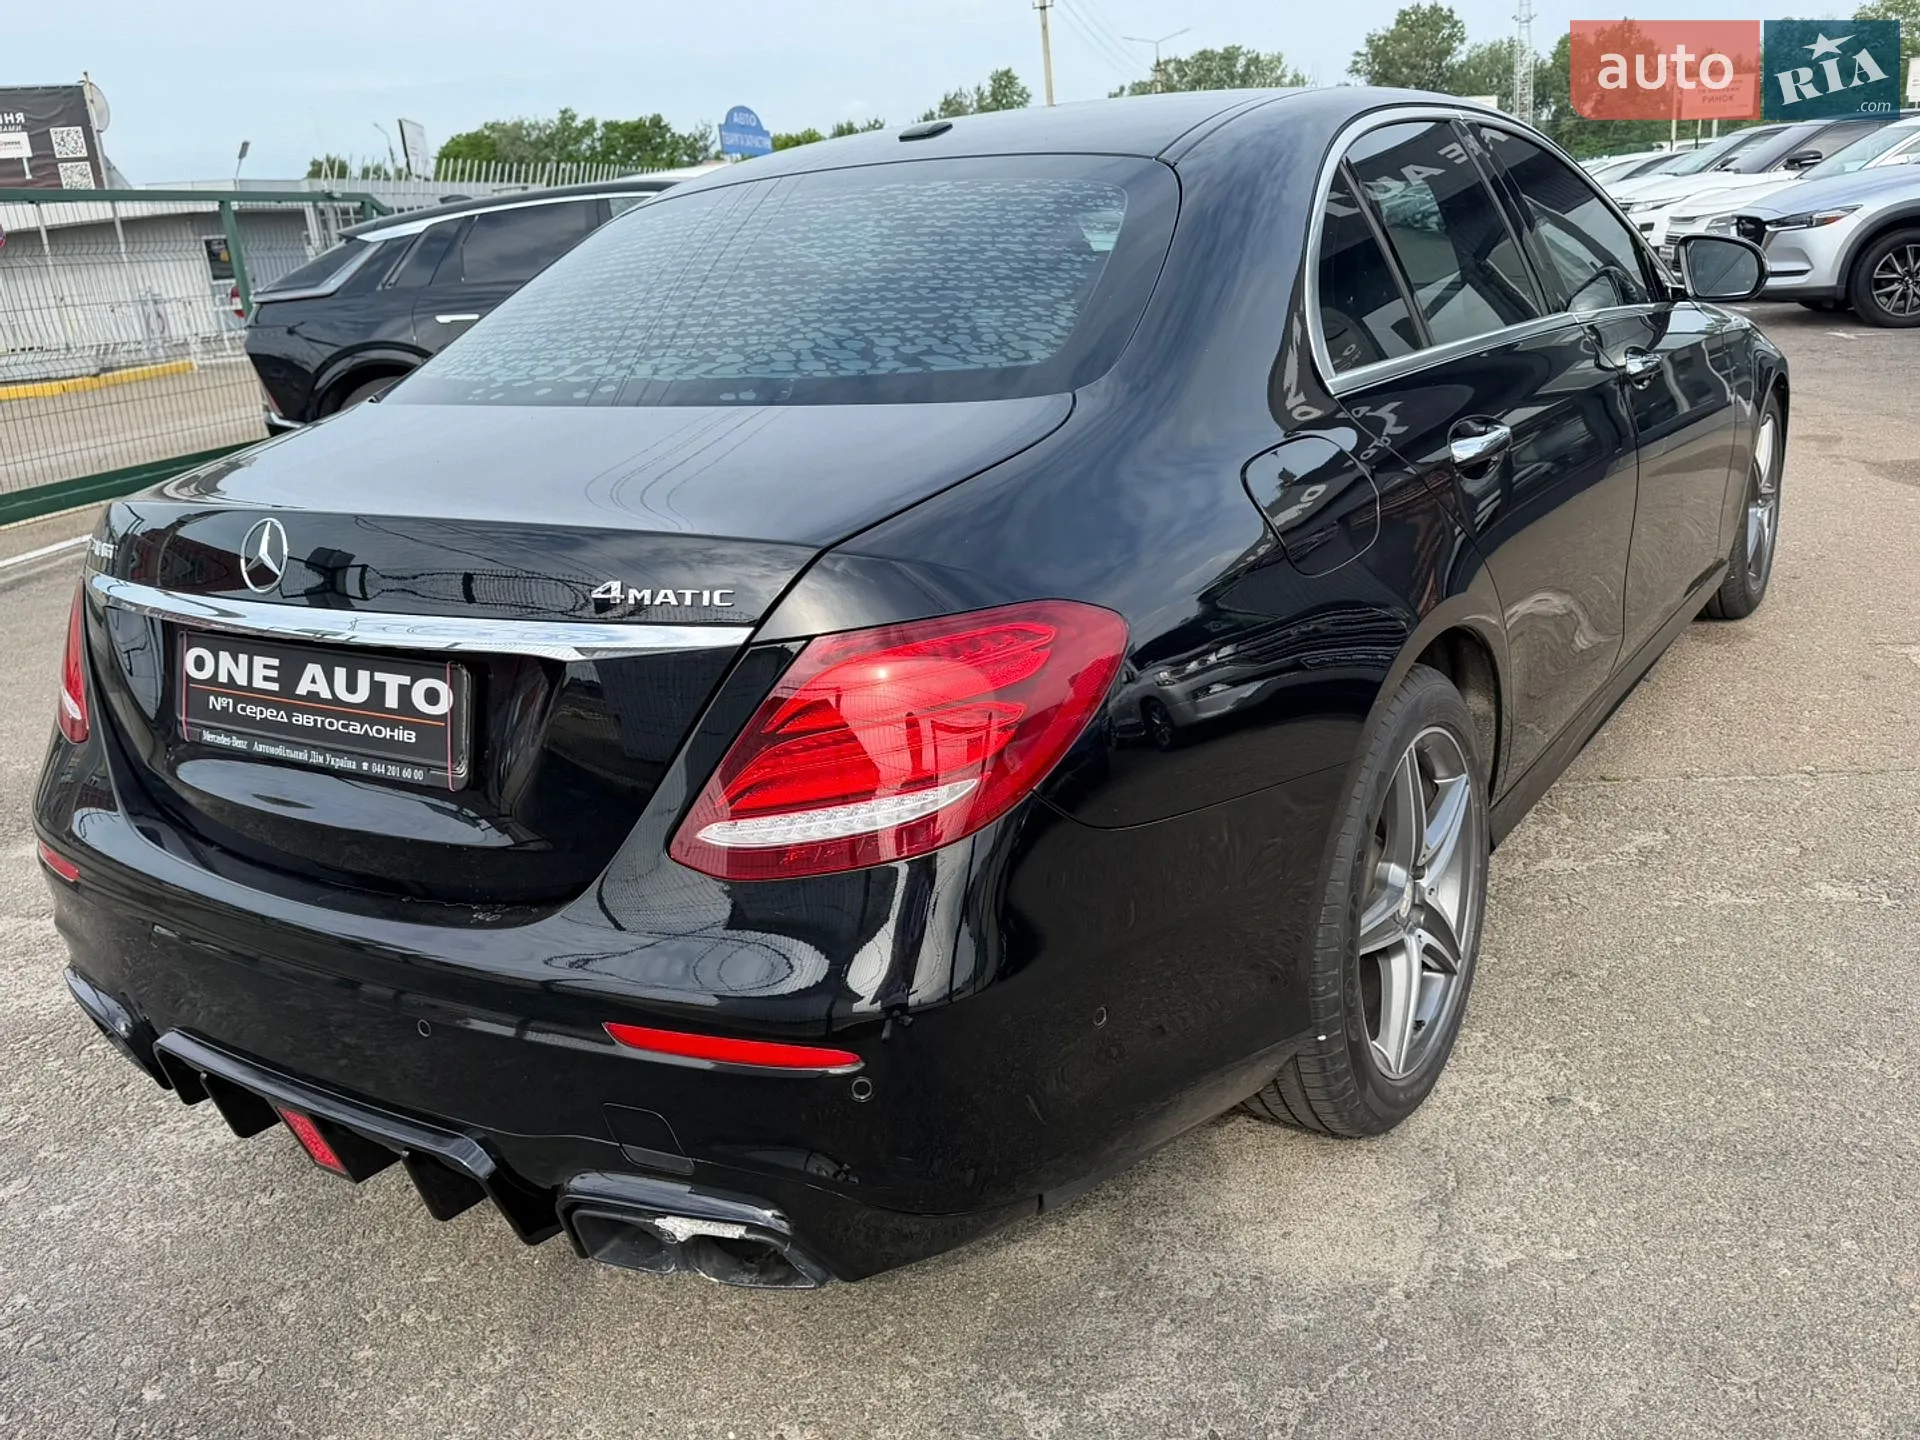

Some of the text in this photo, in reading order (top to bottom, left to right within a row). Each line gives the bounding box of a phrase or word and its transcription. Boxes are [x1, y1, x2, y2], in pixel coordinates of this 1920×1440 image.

[591, 580, 735, 607] 4MATIC
[185, 647, 453, 716] ONE AUTO
[209, 695, 416, 743] №1 серед автосалонів
[202, 730, 424, 780] Mercedes-Benz Автомобільний Дім Україна 044 201 60 00
